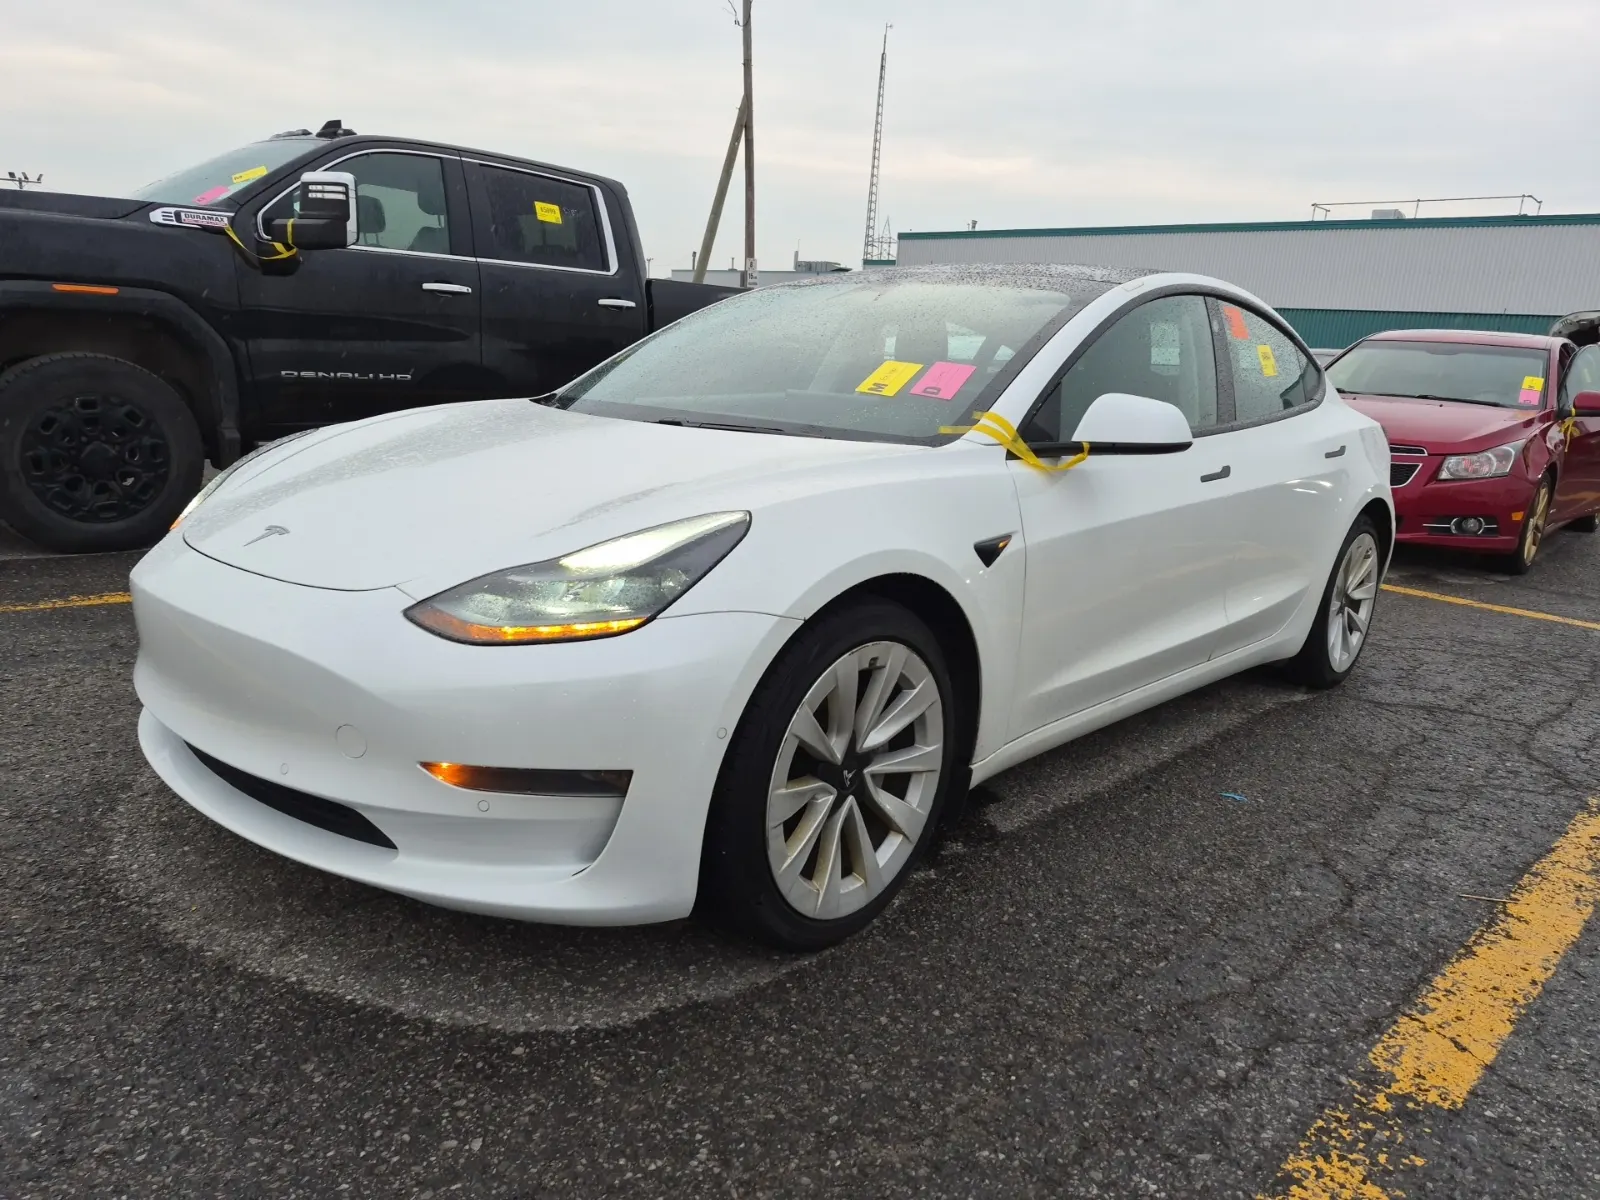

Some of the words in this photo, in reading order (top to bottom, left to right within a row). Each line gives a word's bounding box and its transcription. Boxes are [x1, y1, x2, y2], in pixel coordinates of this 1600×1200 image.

[184, 213, 225, 222] DURAMAX
[280, 370, 374, 380] DENALI
[379, 373, 412, 381] HD
[867, 382, 889, 393] M
